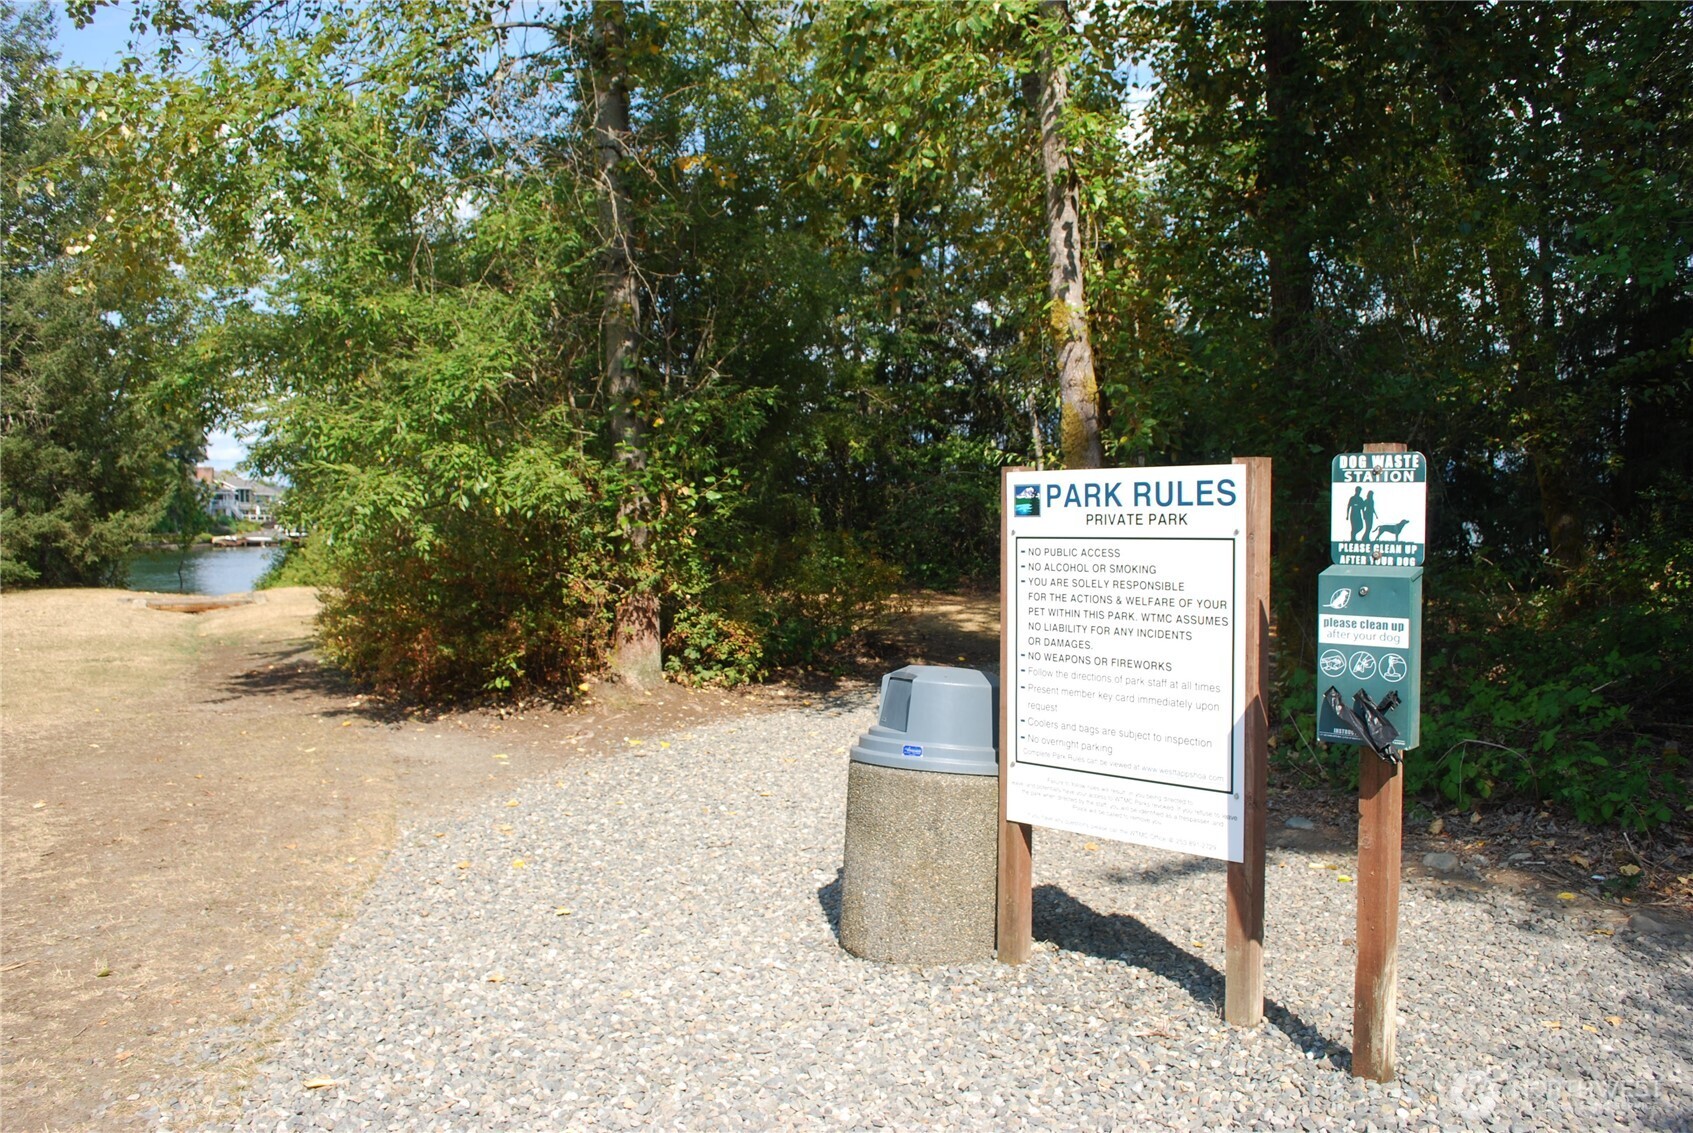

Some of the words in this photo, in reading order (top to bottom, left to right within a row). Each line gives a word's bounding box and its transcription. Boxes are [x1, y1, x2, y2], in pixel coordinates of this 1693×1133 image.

[1340, 456, 1366, 468] DOG
[1372, 455, 1419, 468] WASTE
[1344, 471, 1414, 482] STATION
[1047, 483, 1122, 508] PARK
[1134, 479, 1236, 507] RULES
[1086, 514, 1143, 525] PRIVATE
[1149, 513, 1188, 525] PARK
[1028, 548, 1041, 556] NO
[1044, 548, 1077, 557] PUBLIC
[1081, 549, 1120, 558] ACCESS
[1339, 543, 1370, 553] PLEASE
[1373, 544, 1402, 553] CLEAN
[1405, 545, 1417, 554] UP
[1340, 555, 1366, 564] AFTER
[1397, 557, 1415, 566] DOG
[1028, 563, 1041, 571] NO
[1044, 563, 1089, 573] ALCOHOL
[1092, 564, 1106, 573] OR
[1110, 565, 1157, 574] SMOKING
[1028, 578, 1047, 586] YOU
[1050, 579, 1069, 587] ARE
[1072, 579, 1110, 589] SOLELY
[1113, 580, 1185, 591] RESPONSIBLE
[1028, 592, 1046, 601] FOR
[1050, 593, 1067, 602] THE
[1070, 594, 1113, 604] ACTIONS
[1117, 596, 1122, 605] &
[1125, 596, 1175, 607] WELFARE
[1179, 598, 1193, 607] OF
[1197, 600, 1227, 610] YOUR
[1028, 607, 1045, 616] PET
[1048, 608, 1080, 618] WITHIN
[1084, 610, 1104, 619] THIS
[1108, 611, 1138, 621] PARK.
[1142, 613, 1172, 624] WTMC
[1176, 615, 1229, 626] ASSUMES
[1028, 622, 1041, 631] NO
[1044, 623, 1088, 634] LIABILITY
[1091, 625, 1110, 635] FOR
[1113, 627, 1133, 637] ANY
[1137, 628, 1192, 640] INCIDENTS
[1324, 618, 1357, 628] please
[1360, 620, 1388, 630] clean
[1392, 622, 1404, 632] up
[1028, 637, 1041, 646] OR
[1044, 638, 1093, 650] DAMAGES.
[1327, 630, 1350, 639] after
[1353, 631, 1376, 641] your
[1379, 632, 1400, 645] dog
[1028, 652, 1041, 660] NO
[1044, 653, 1091, 665] WEAPONS
[1094, 657, 1108, 666] OR
[1111, 658, 1172, 671] FIREWORKS
[1028, 667, 1053, 678] Follow
[1056, 670, 1068, 679] the
[1071, 672, 1112, 683] directions
[1115, 675, 1123, 684] of
[1125, 677, 1145, 686] park
[1148, 678, 1167, 687] staff
[1181, 682, 1192, 690] all
[1195, 682, 1221, 693] times
[1028, 684, 1059, 695] Present
[1061, 688, 1095, 699] member
[1098, 691, 1112, 702] key
[1115, 693, 1135, 703] card
[1138, 695, 1192, 710] immediately
[1195, 703, 1219, 712] upon
[1028, 703, 1058, 712] request
[1028, 717, 1058, 729] Coolers
[1061, 722, 1076, 732] and
[1079, 724, 1099, 735] bags
[1102, 728, 1116, 736] are
[1119, 728, 1151, 742] subject
[1153, 733, 1162, 742] to
[1165, 735, 1212, 748] inspection
[1028, 734, 1039, 743] No
[1041, 737, 1078, 750] overnight
[1081, 742, 1113, 755] parking
